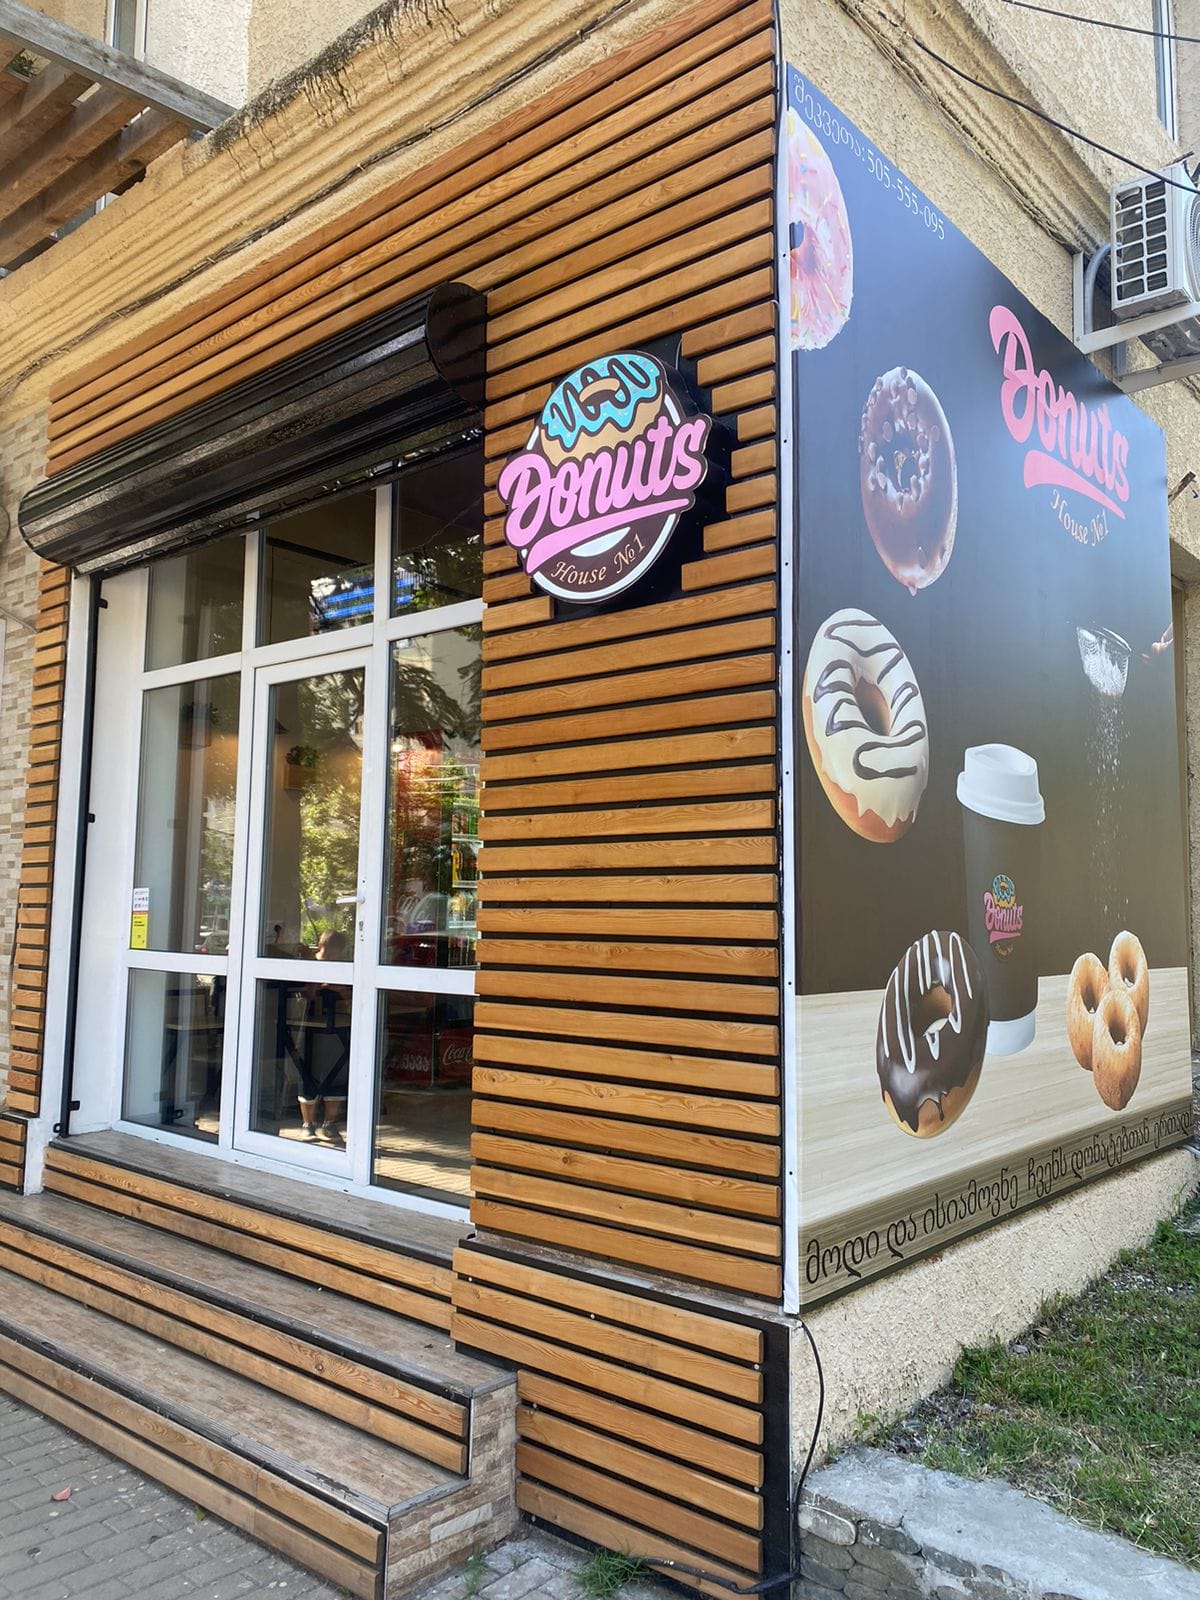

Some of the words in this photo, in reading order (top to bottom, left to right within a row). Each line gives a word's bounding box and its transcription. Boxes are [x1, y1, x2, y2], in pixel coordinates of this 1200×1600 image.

[989, 305, 1130, 502] Donuts
[498, 415, 706, 547] Donuts
[1050, 488, 1089, 545] House
[550, 561, 607, 585] House
[984, 892, 1023, 932] Donuts
[806, 1230, 879, 1284] მოდი
[887, 1213, 917, 1259] და
[923, 1168, 1018, 1234] ისიამოვნე
[1027, 1146, 1067, 1198] ჩვენს
[1071, 1117, 1150, 1180] დონატებთან
